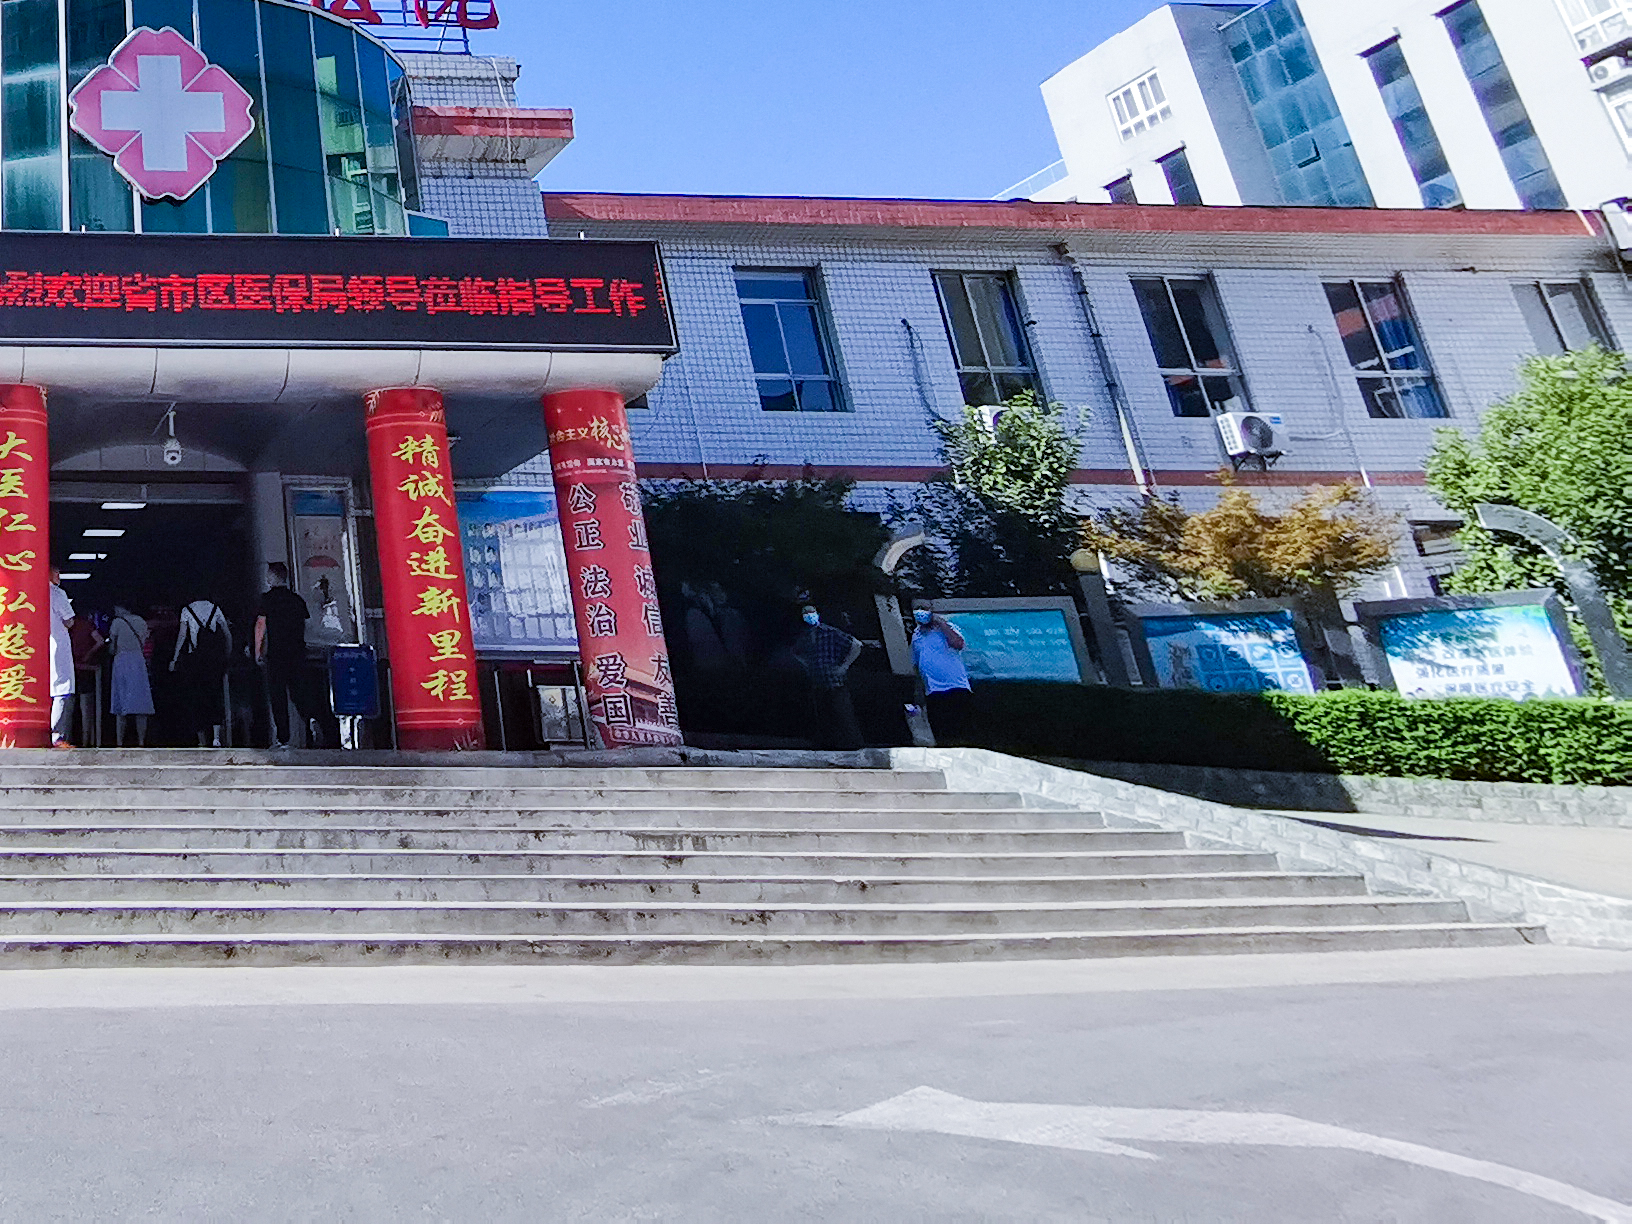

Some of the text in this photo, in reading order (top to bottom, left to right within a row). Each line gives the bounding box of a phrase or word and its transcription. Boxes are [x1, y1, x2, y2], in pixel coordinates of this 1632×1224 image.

[569, 482, 605, 551] 公正
[391, 433, 474, 703] 精诚奋进新里程
[580, 564, 618, 638] 法治
[595, 652, 634, 727] 爱国
